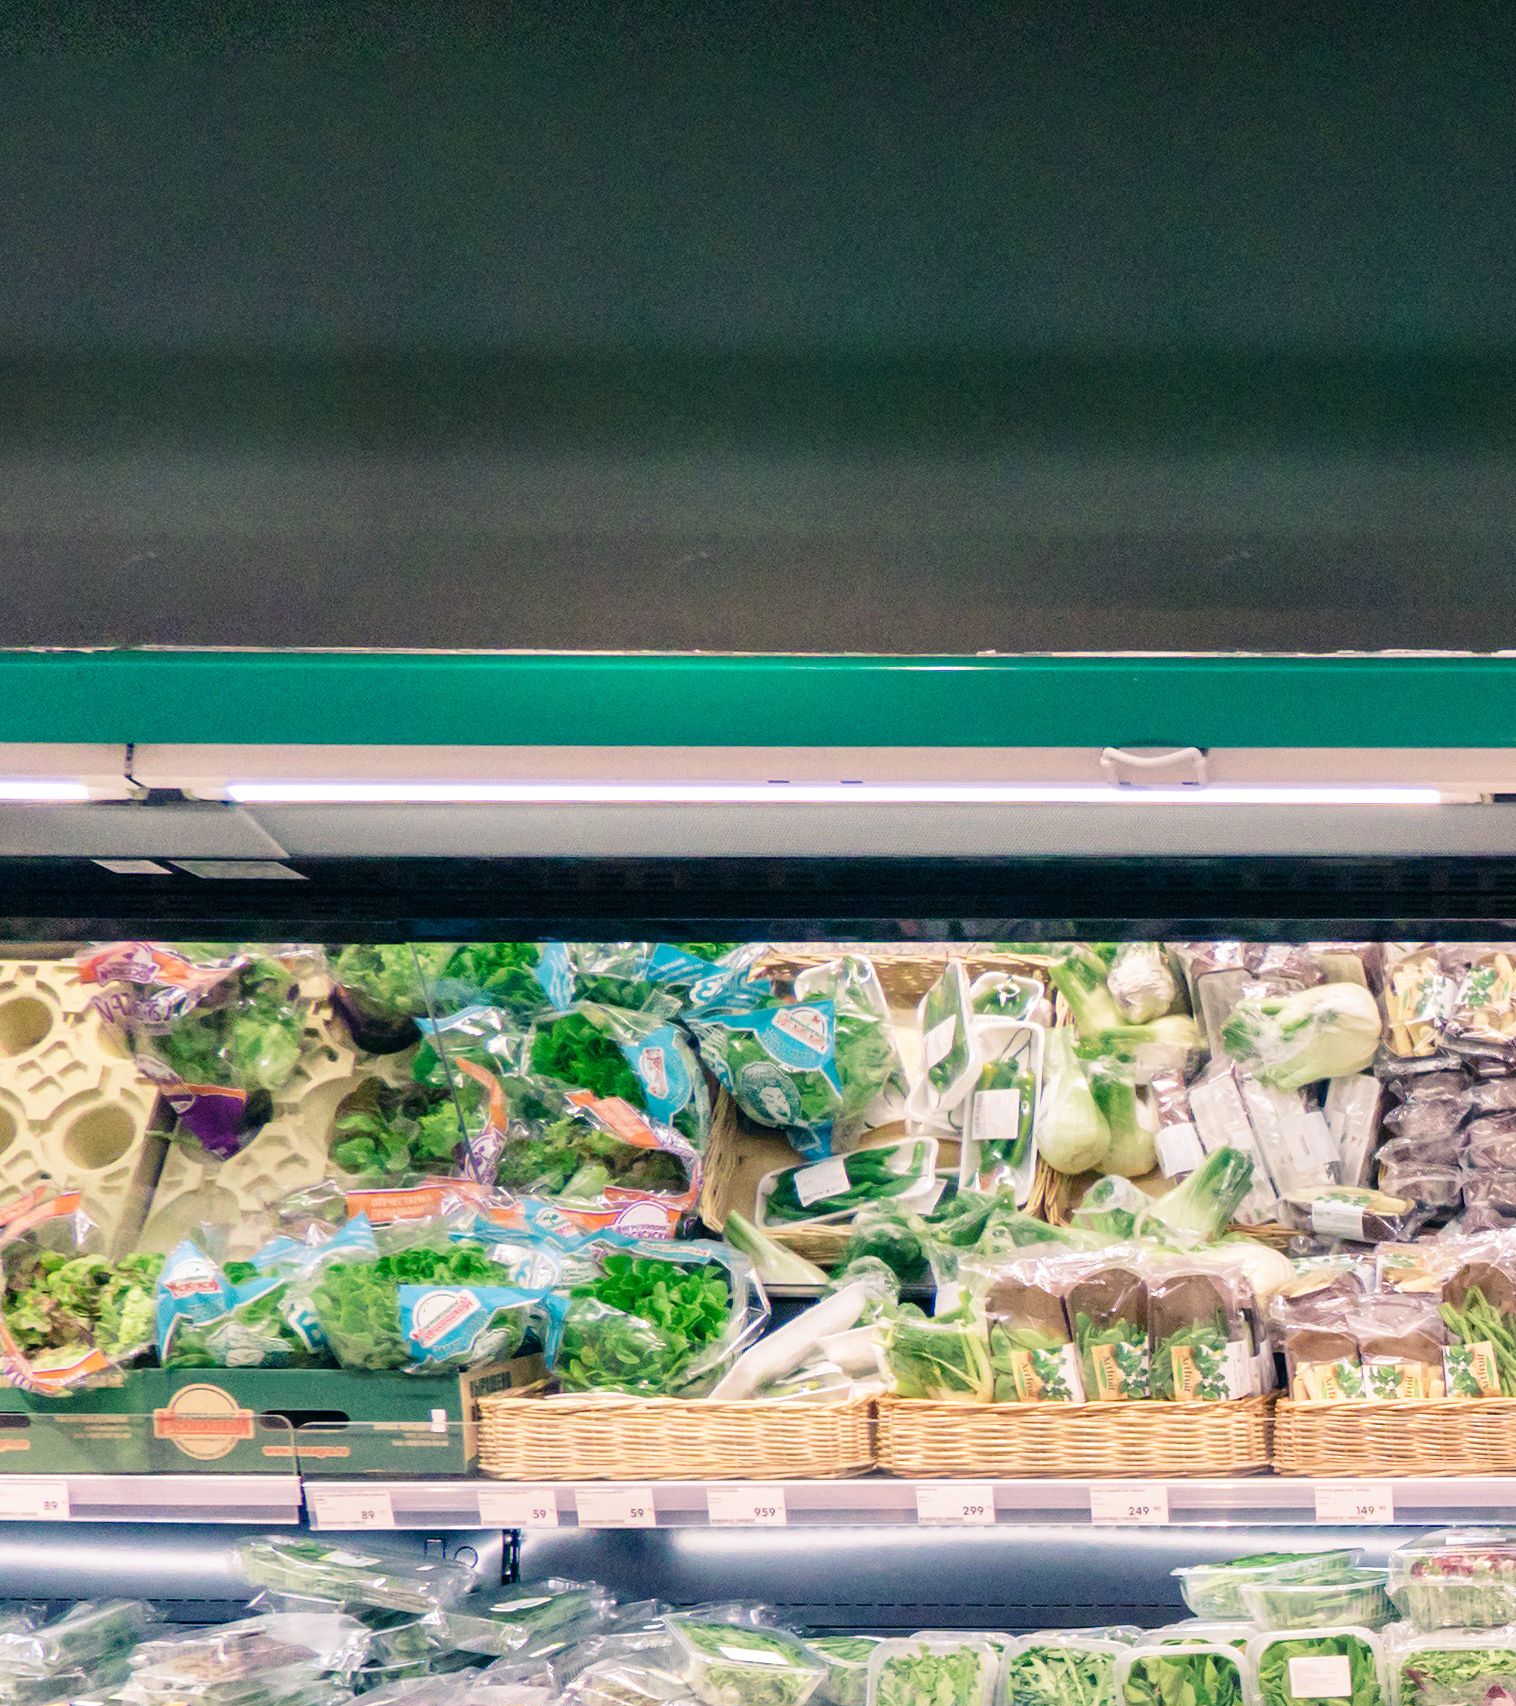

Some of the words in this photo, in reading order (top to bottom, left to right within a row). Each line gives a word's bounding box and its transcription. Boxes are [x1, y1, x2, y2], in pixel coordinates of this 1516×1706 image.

[361, 1510, 374, 1520] 89
[533, 1509, 547, 1519] 59
[630, 1508, 644, 1518] 59
[754, 1507, 776, 1517] 959
[963, 1506, 984, 1516] 299
[1128, 1506, 1149, 1516] 249
[1356, 1505, 1375, 1515] 149
